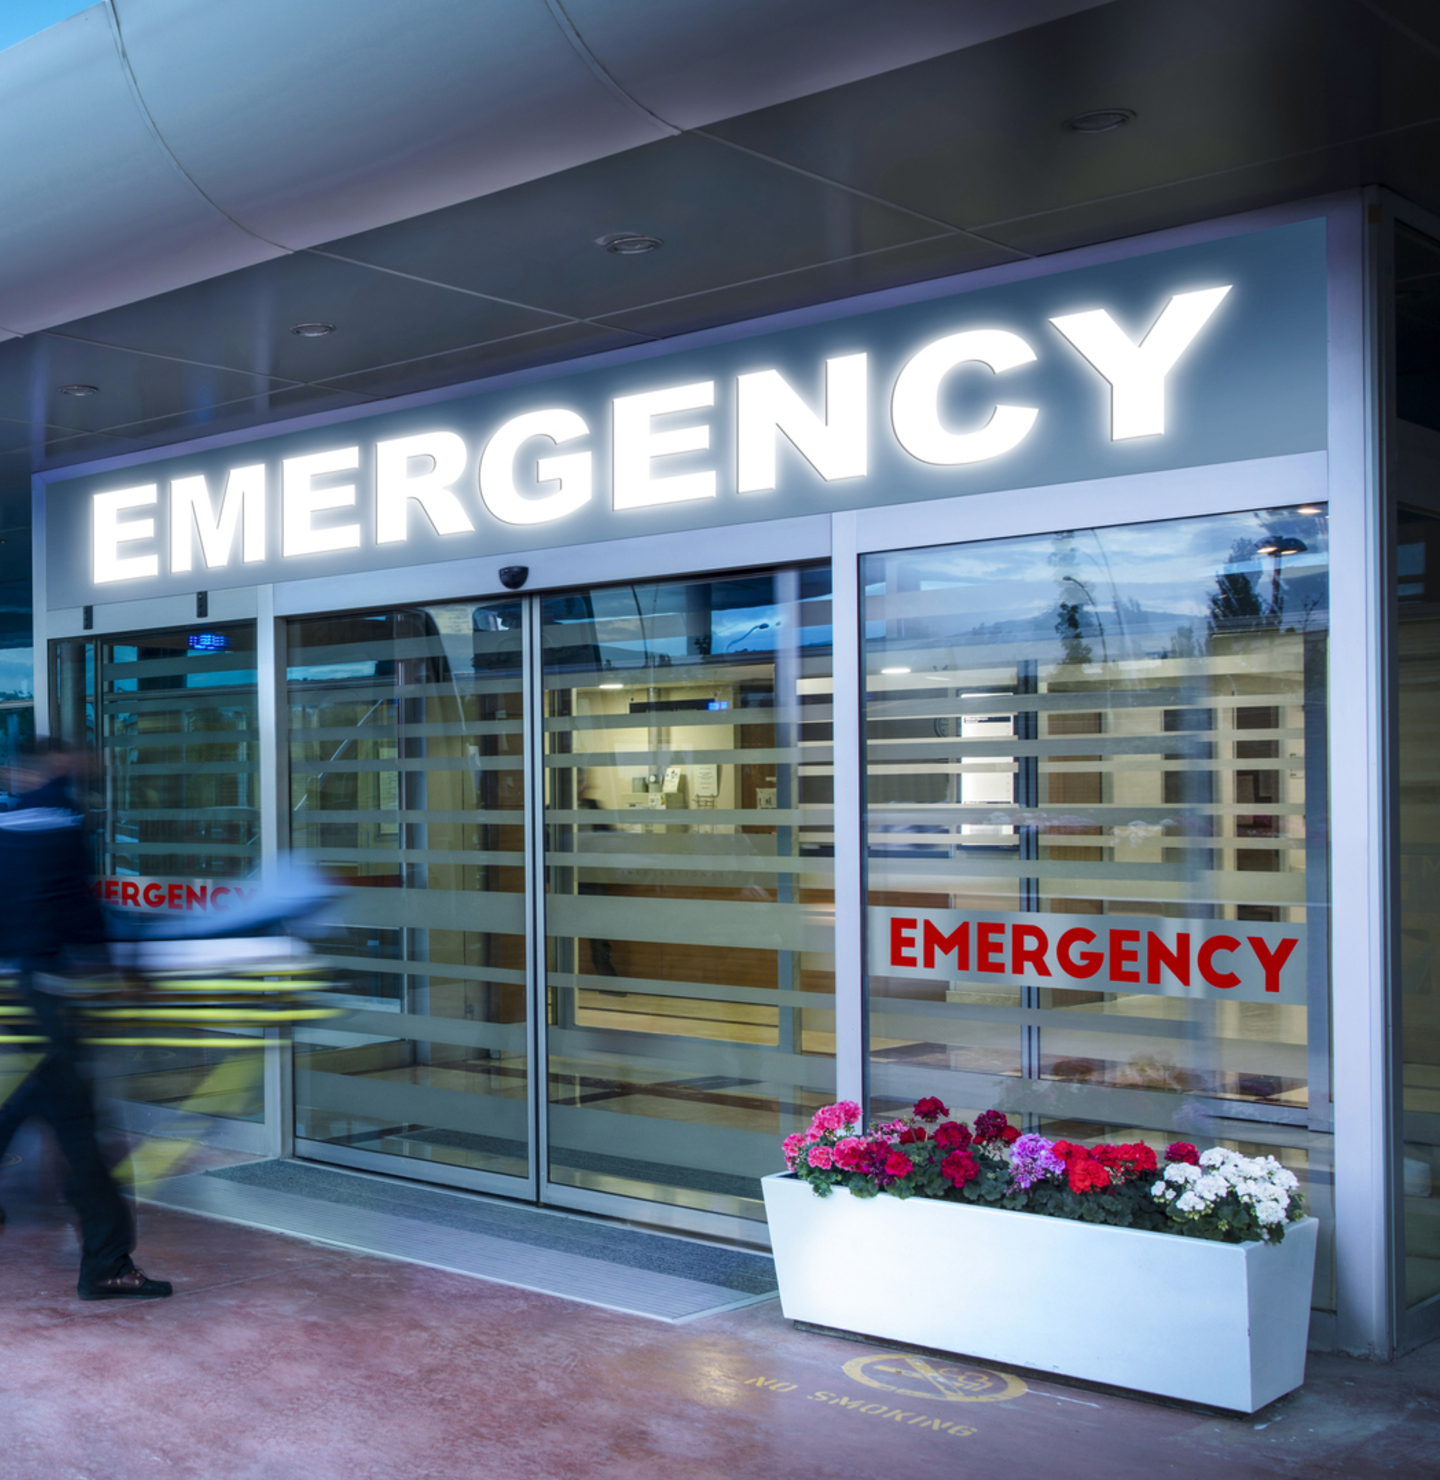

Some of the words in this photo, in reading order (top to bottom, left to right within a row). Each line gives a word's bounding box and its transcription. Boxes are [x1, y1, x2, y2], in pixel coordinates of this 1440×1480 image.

[91, 285, 1233, 585] EMERGENCY
[81, 880, 257, 911] MERGENCY
[890, 917, 1299, 993] EMERGENCY
[743, 1376, 799, 1393] NO
[806, 1391, 979, 1437] SMOKING
